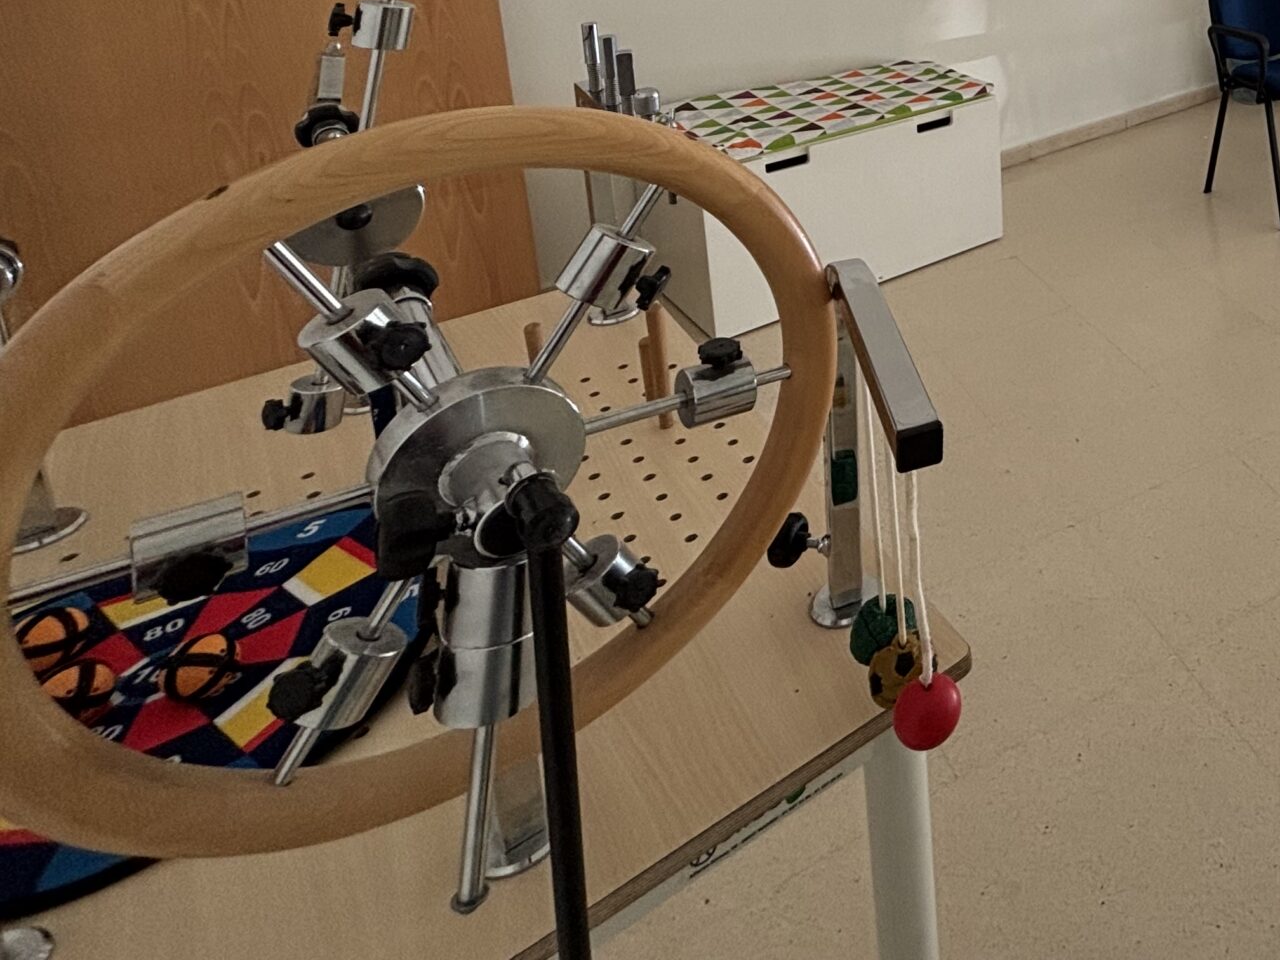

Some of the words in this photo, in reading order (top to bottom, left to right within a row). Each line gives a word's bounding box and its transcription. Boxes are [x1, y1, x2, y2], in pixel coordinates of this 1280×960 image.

[296, 519, 327, 538] 5
[254, 558, 290, 577] 60
[241, 607, 272, 630] 80
[143, 618, 185, 641] 80
